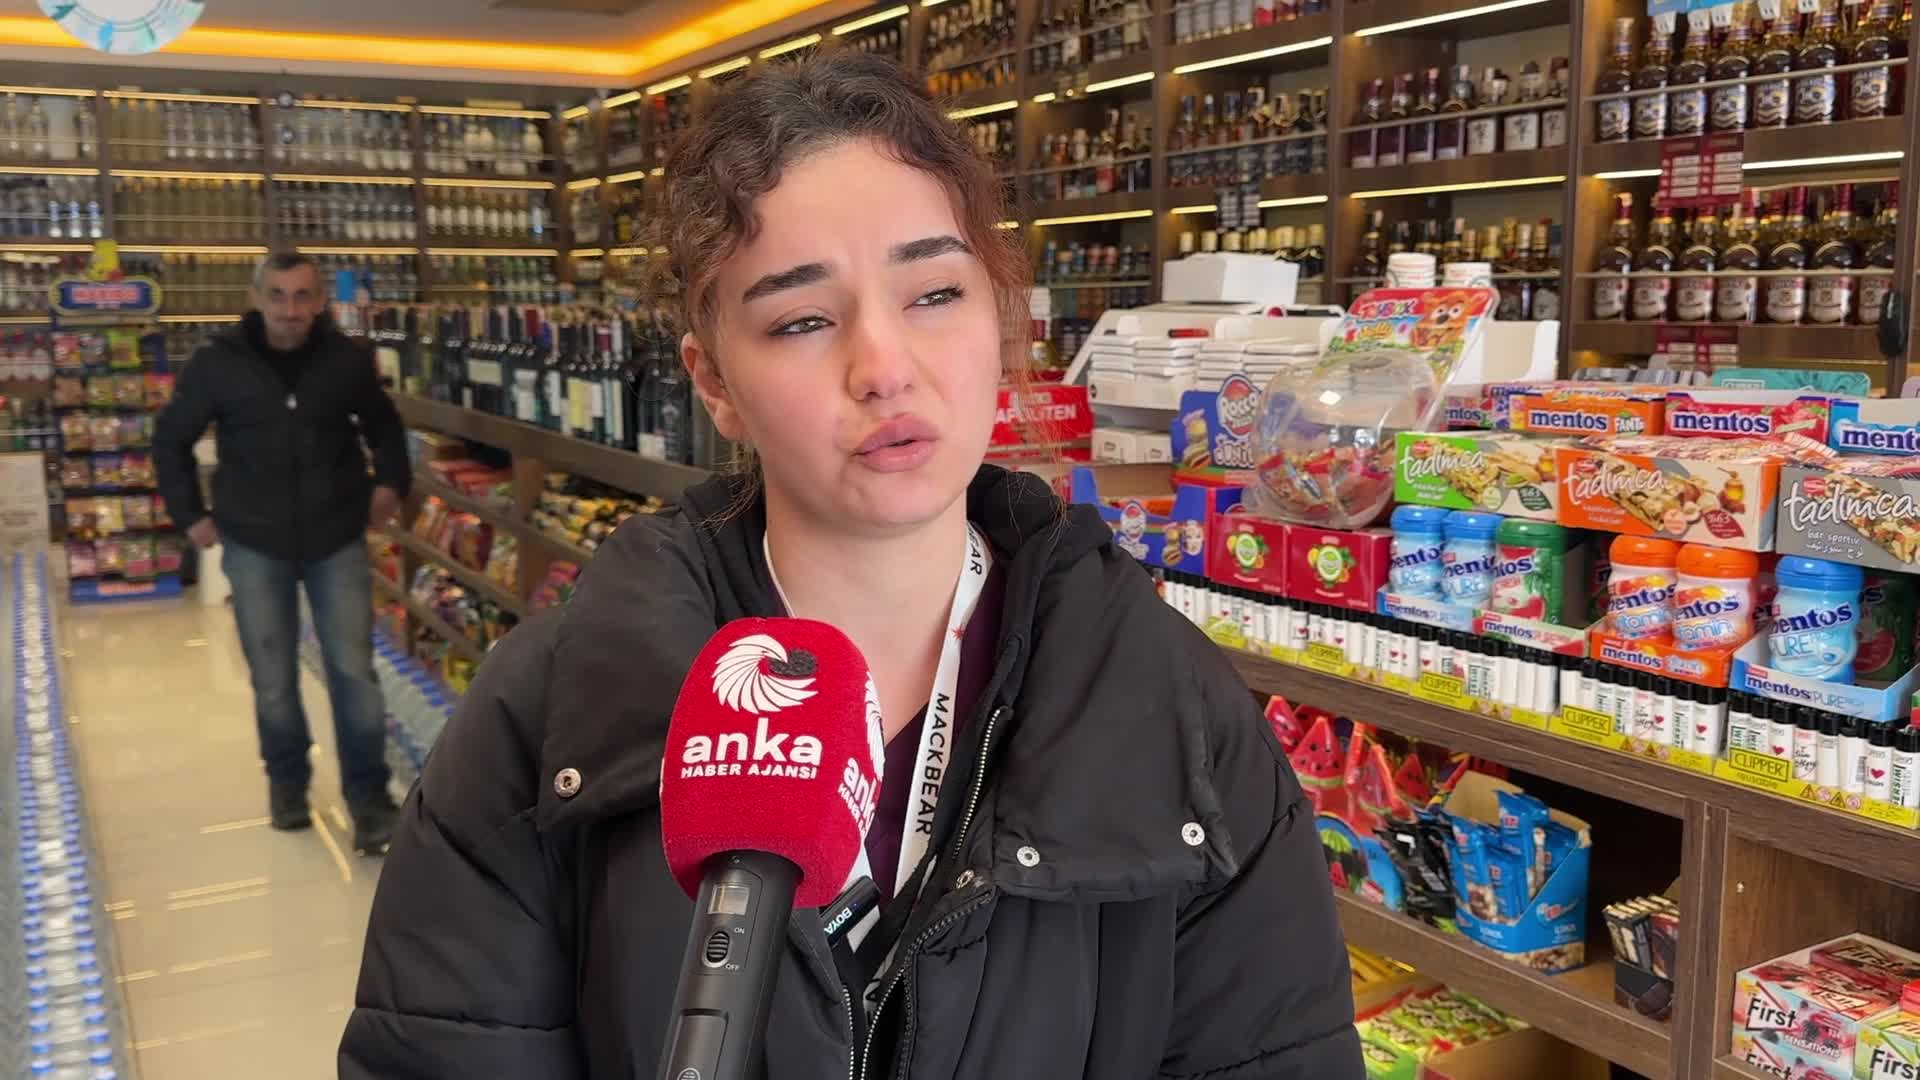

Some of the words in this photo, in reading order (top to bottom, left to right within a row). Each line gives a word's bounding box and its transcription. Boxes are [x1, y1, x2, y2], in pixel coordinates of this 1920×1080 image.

[1531, 411, 1607, 431] mentos
[1674, 413, 1769, 433] mentos
[1841, 428, 1920, 449] ment
[1385, 603, 1430, 620] mentos
[1484, 619, 1533, 639] mentos
[1603, 647, 1662, 668] mentos
[1747, 676, 1811, 700] mentos
[1564, 708, 1609, 731] CLIPPER
[682, 717, 823, 766] anka
[681, 763, 742, 779] HABER
[748, 763, 818, 780] AJANSI
[915, 692, 950, 835] MACKBEAR
[1734, 752, 1783, 776] CLIPPER
[734, 926, 745, 935] ON
[823, 906, 853, 935] BOYA
[725, 963, 740, 971] OFF
[1748, 995, 1797, 1029] First
